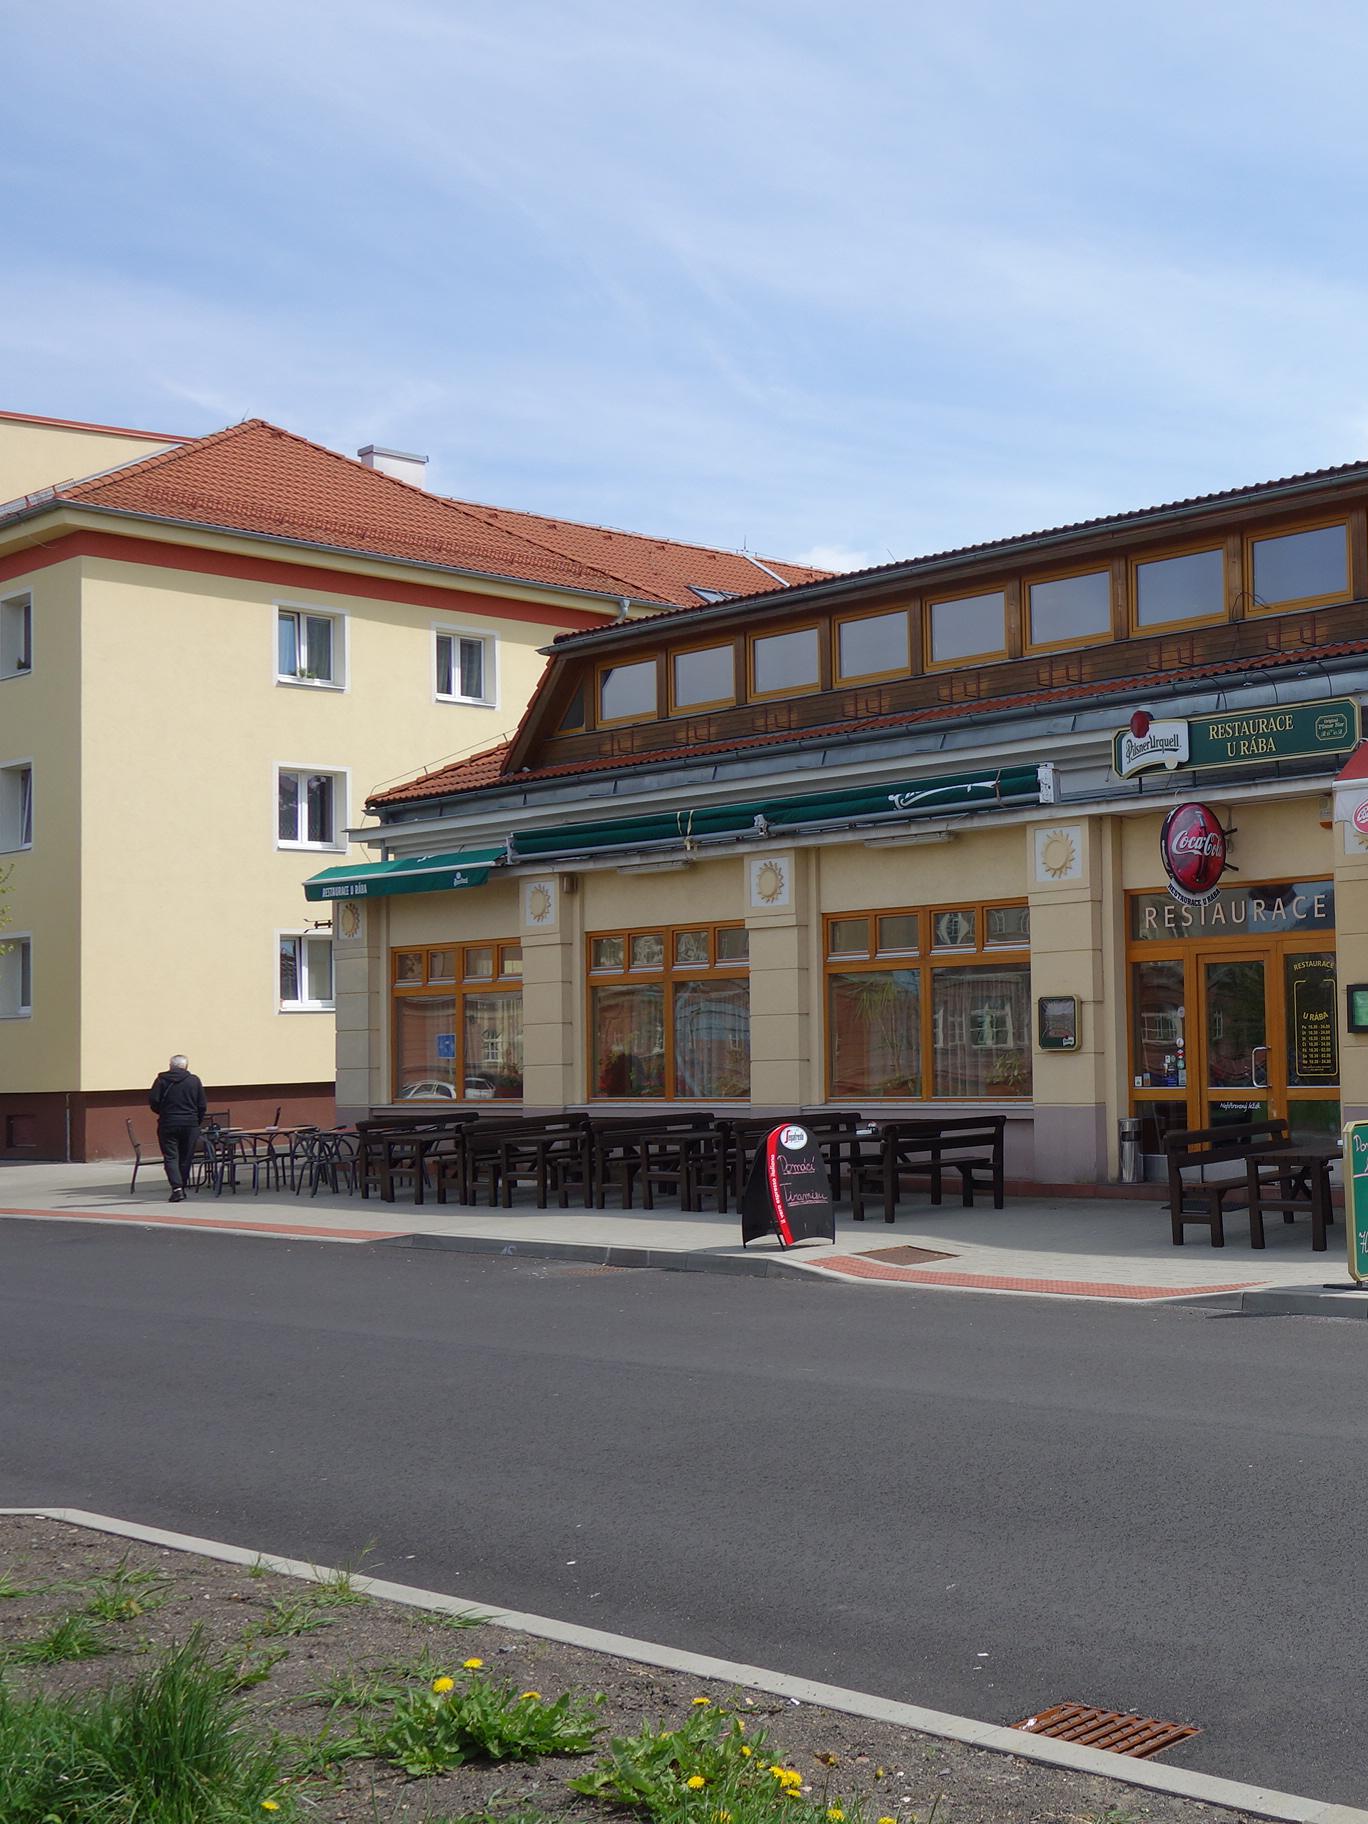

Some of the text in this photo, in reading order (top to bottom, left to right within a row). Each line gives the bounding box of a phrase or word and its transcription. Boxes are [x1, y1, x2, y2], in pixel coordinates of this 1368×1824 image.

[1209, 714, 1294, 740] RESTAURACE
[1227, 737, 1276, 757] U RÁBA
[1171, 831, 1223, 857] Coca-Cola
[1168, 883, 1202, 907] RESTAURACE
[1145, 894, 1327, 929] RESTAURACE
[1293, 960, 1336, 972] RESTAURACE
[1303, 1012, 1309, 1020] U
[777, 1155, 816, 1174] Domácí
